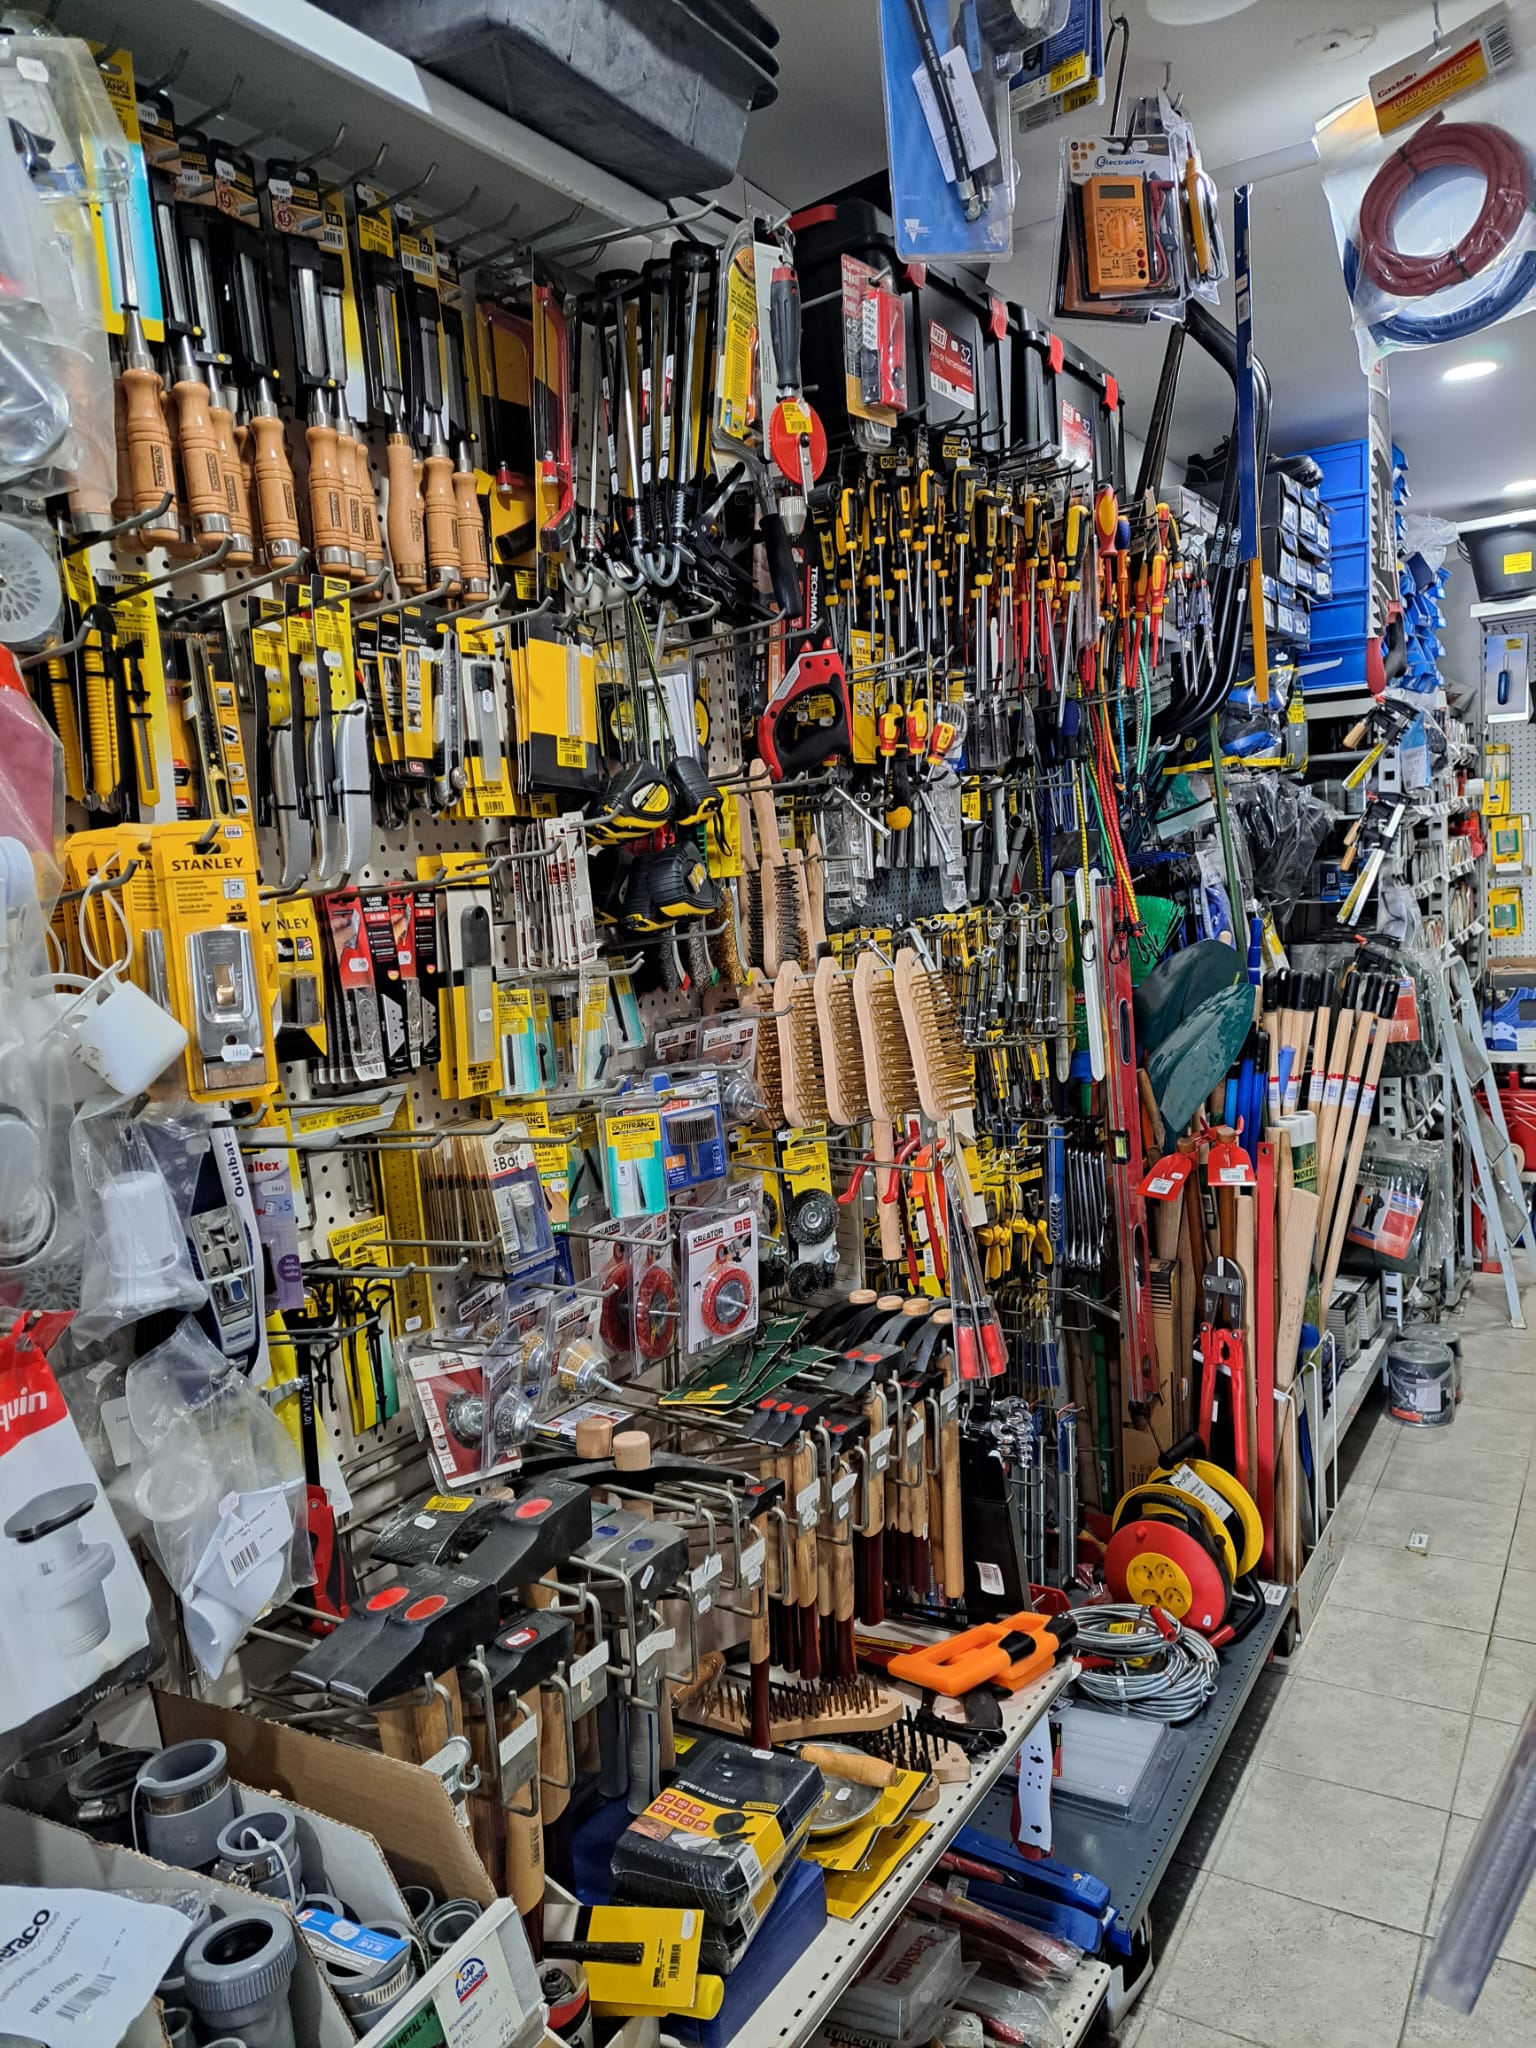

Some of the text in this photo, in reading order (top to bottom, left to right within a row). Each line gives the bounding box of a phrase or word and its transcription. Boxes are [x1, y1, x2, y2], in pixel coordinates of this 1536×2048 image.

[1377, 71, 1417, 99] Castolin
[1095, 155, 1146, 168] Electraline
[960, 343, 972, 366] 32
[1081, 418, 1092, 436] 32
[171, 857, 243, 871] STANLEY
[230, 902, 243, 911] x5
[276, 919, 309, 930] NLEY
[298, 948, 313, 957] USA
[658, 1034, 679, 1045] KREATOR
[707, 1033, 733, 1045] KREATOR
[611, 1120, 656, 1132] OUTIFRANCE
[224, 1140, 245, 1198] Outibat
[246, 1160, 280, 1173] altex
[541, 1171, 567, 1180] PONCER
[331, 1231, 351, 1244] OUTIFR
[350, 1223, 384, 1239] OUTIFRANCE
[692, 1227, 724, 1244] KREATOR
[461, 1292, 487, 1313] KREATOR
[509, 1300, 536, 1319] KREATOR
[558, 1306, 585, 1325] KREATOR
[226, 1329, 252, 1343] Outibat
[438, 1357, 464, 1367] KREATOR
[0, 1908, 51, 1963] eraco
[881, 1935, 938, 1985] Castolin
[461, 1963, 476, 1983] CAP
[456, 1966, 488, 1998] Bricolage
[397, 2021, 422, 2048] METAL
